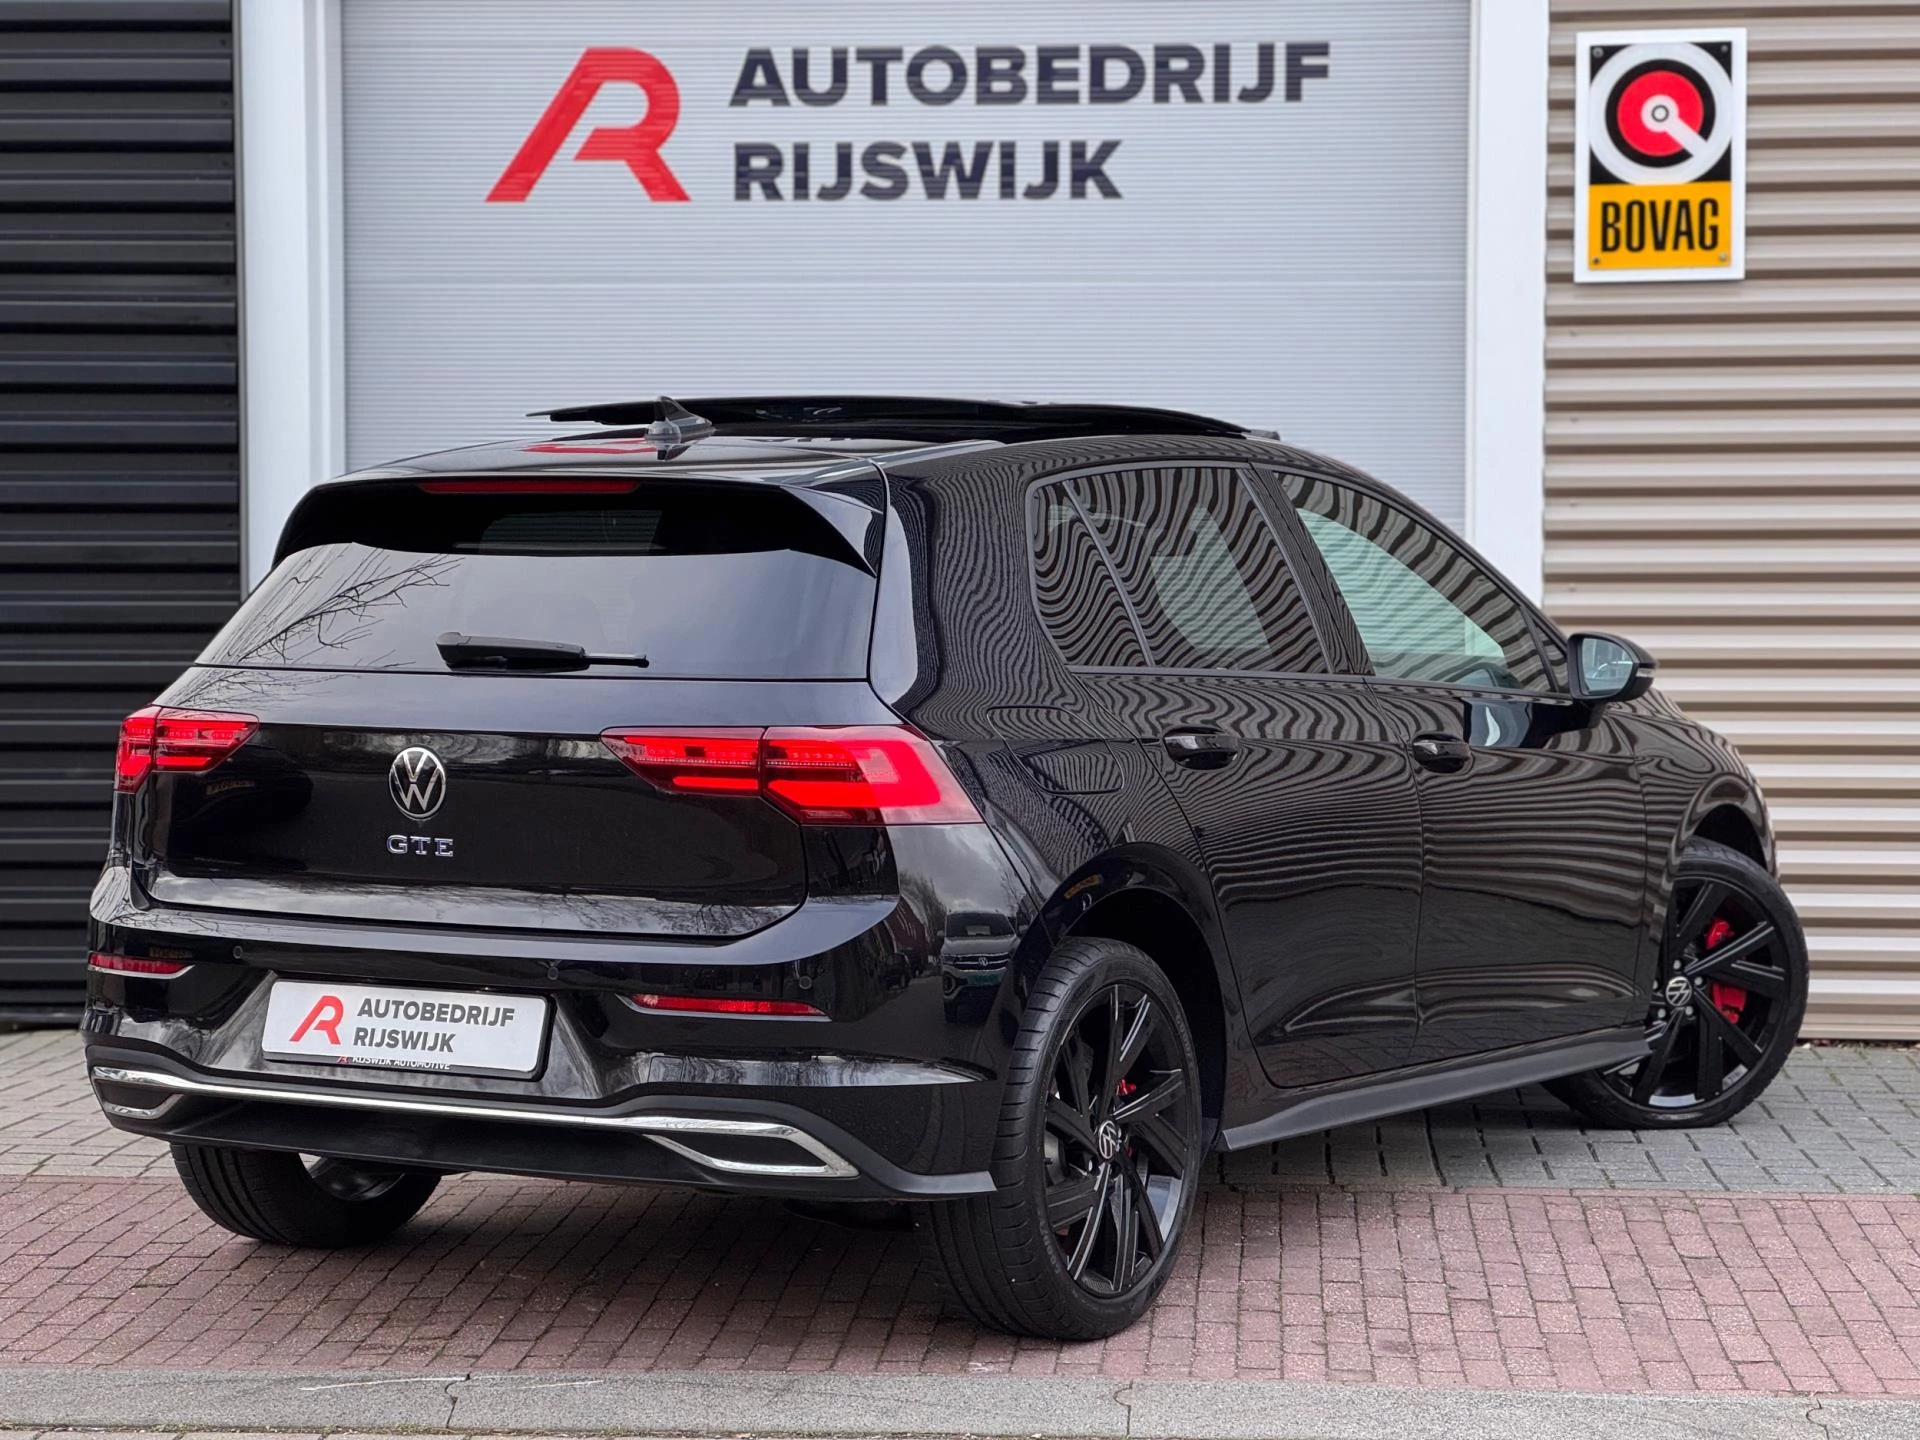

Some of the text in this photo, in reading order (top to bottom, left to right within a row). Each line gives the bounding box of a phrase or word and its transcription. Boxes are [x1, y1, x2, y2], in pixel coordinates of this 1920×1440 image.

[730, 42, 1330, 106] AUTOBEDRIJF
[733, 140, 1123, 201] RIJSWIJK
[1600, 198, 1719, 253] BOVAG
[386, 834, 454, 857] GTE
[357, 998, 515, 1027] AUTOBEDRIJF
[353, 1027, 456, 1052] RIJSWIJK
